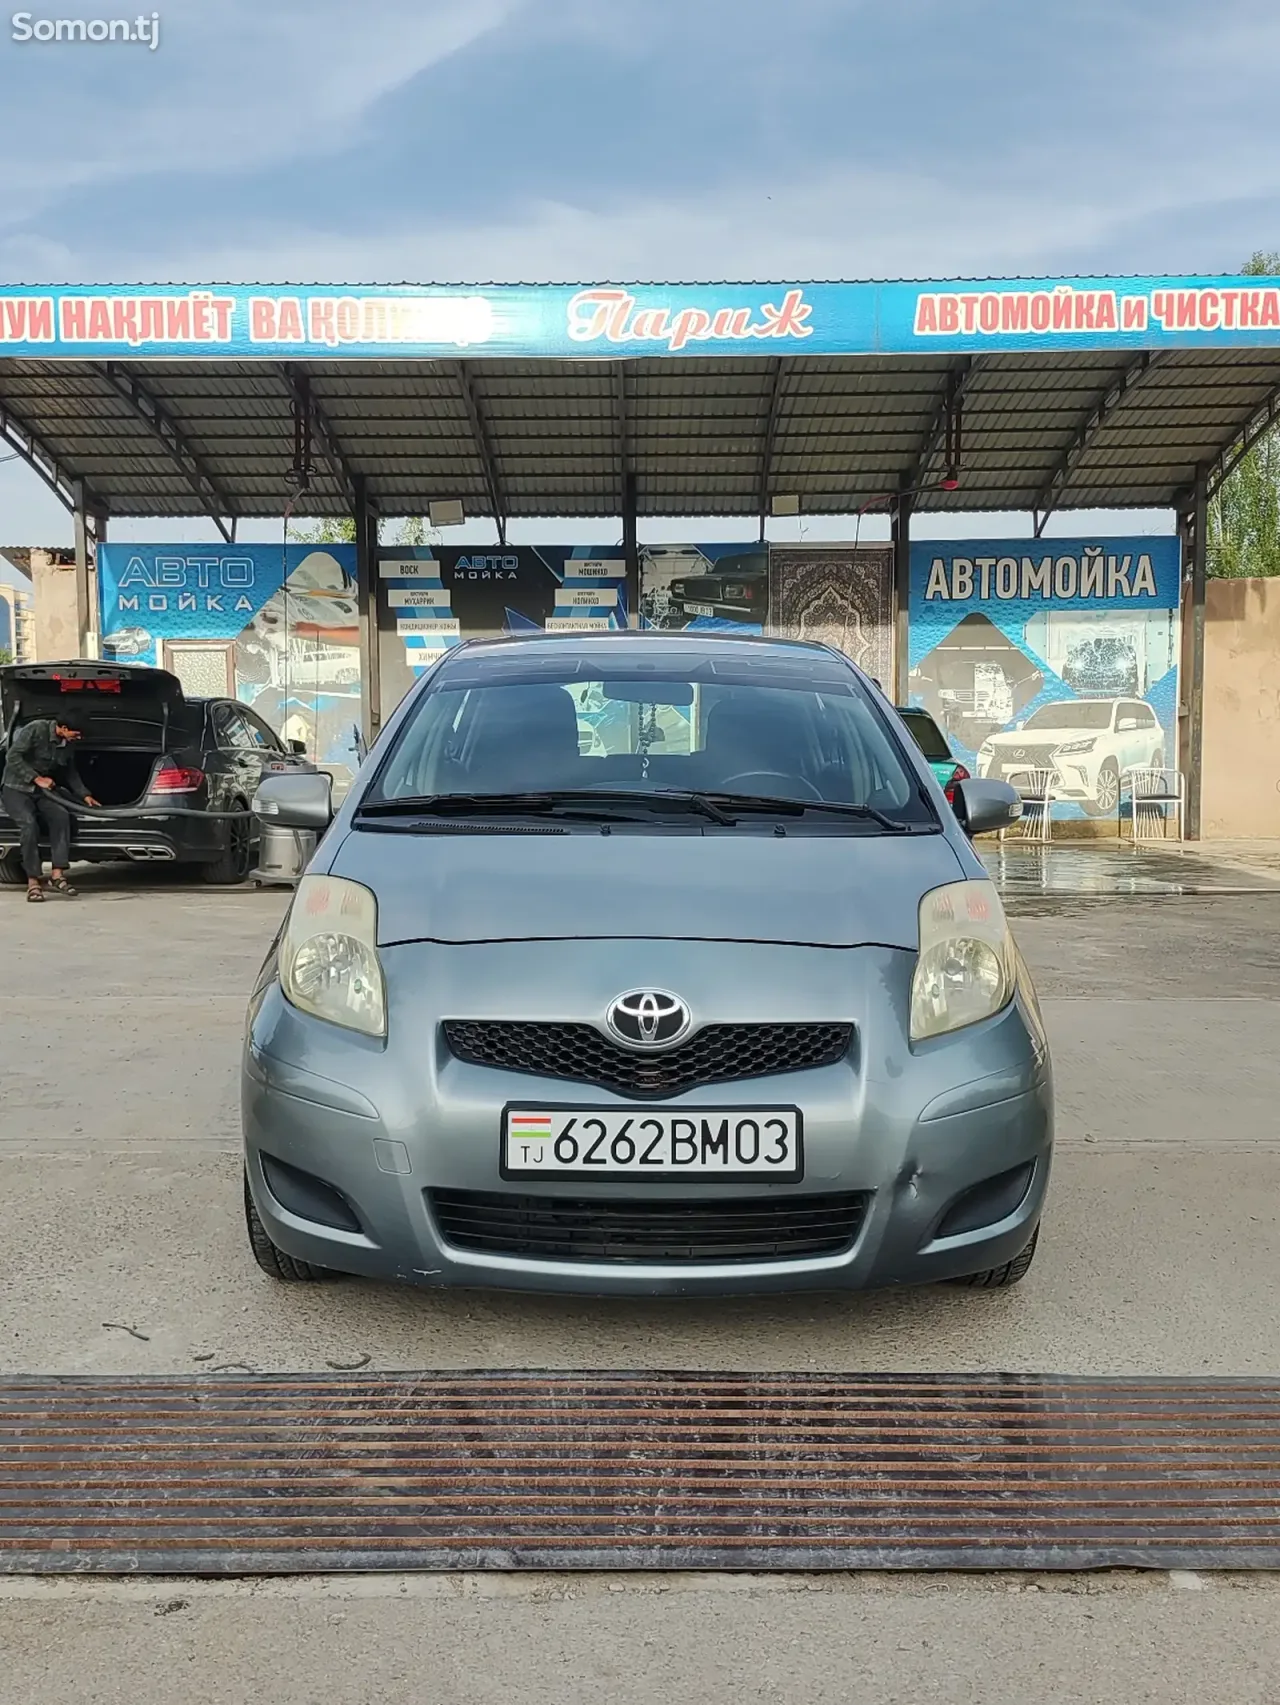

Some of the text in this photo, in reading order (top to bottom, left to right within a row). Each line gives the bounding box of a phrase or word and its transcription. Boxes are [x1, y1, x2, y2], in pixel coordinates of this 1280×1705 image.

[61, 294, 234, 343] НАҚЛИЁТ
[252, 299, 302, 340] ВА
[568, 289, 813, 349] Париж
[916, 288, 1115, 333] АВТОМОЙКА
[1154, 288, 1280, 330] ЧИСТКА
[118, 557, 255, 587] АВТО
[400, 565, 419, 575] ВОСК
[454, 555, 519, 570] АВТО
[454, 571, 518, 580] МОЙКА
[924, 547, 1157, 601] АВТОМОЙКА
[119, 593, 253, 611] МОЙКА
[520, 1118, 789, 1164] TJ 6262BM03
